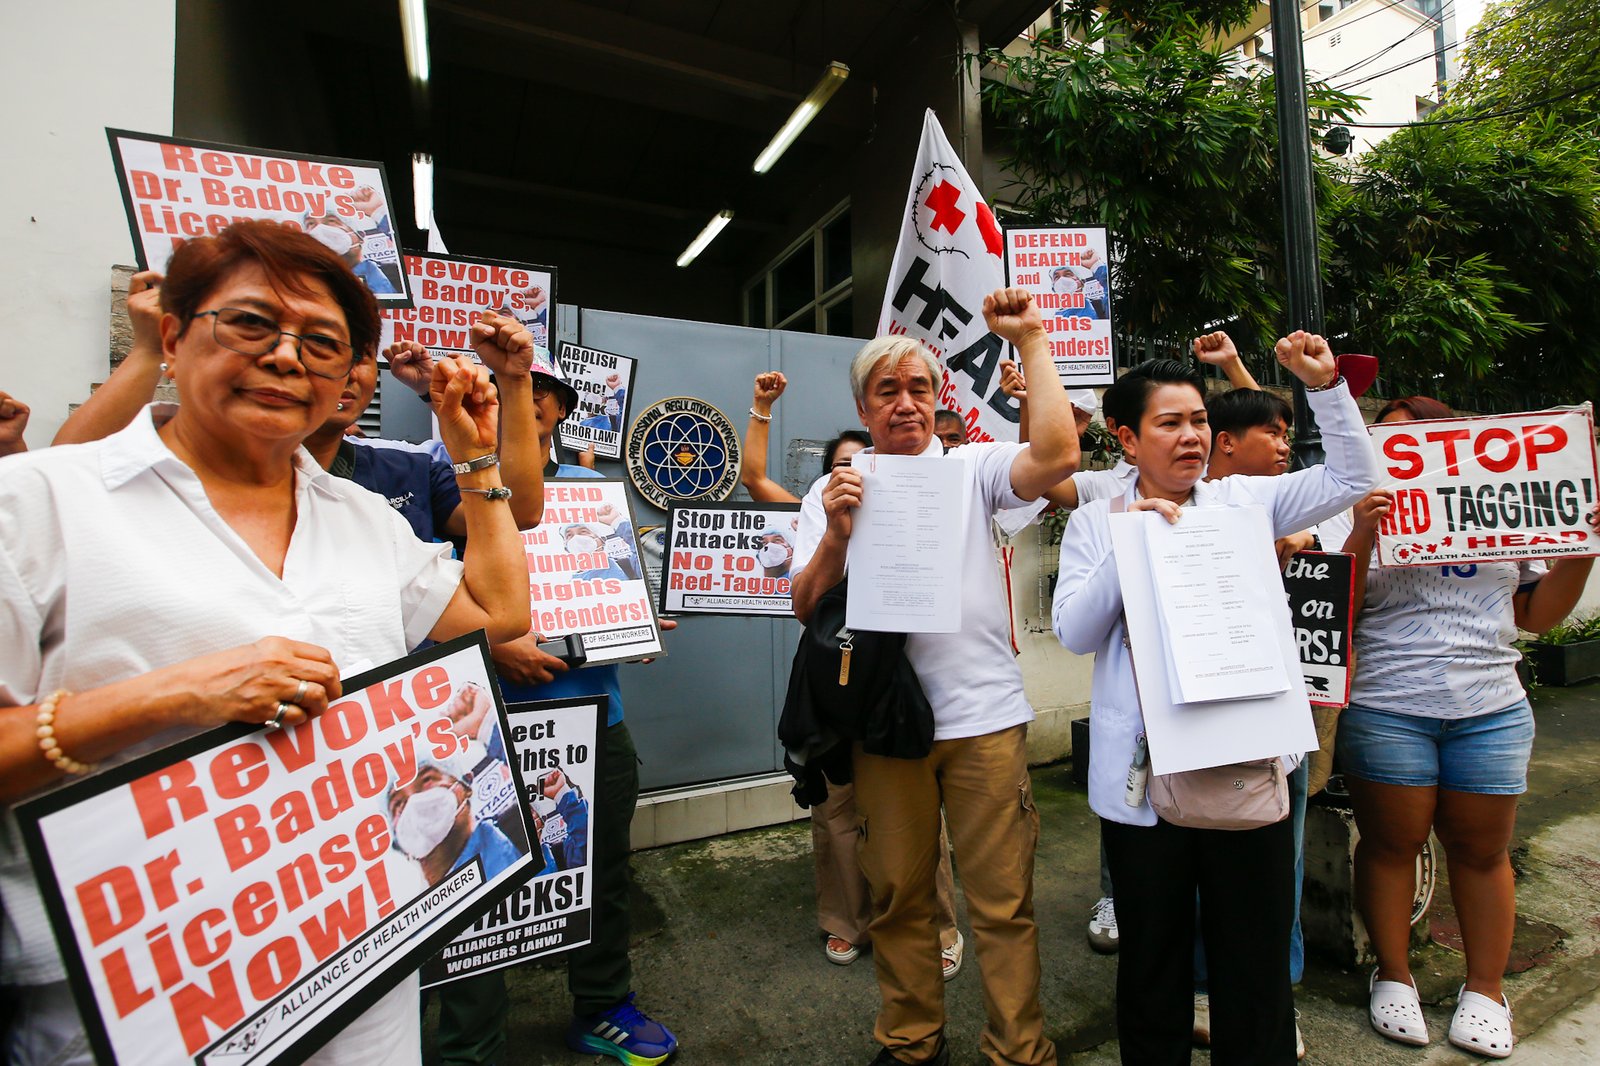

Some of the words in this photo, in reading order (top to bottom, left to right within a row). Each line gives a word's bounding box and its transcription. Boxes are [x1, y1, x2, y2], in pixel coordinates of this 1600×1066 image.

[160, 143, 356, 189] Revoke
[130, 170, 192, 203] Dr.
[200, 177, 364, 220] Badoy's,
[139, 204, 303, 237] Lice
[1014, 233, 1087, 249] DEFEND
[1015, 252, 1082, 267] HEALTH
[404, 255, 530, 288] Revoke
[1017, 272, 1041, 285] and
[1032, 293, 1086, 309] uman
[1045, 317, 1092, 333] ghts
[563, 346, 618, 370] ABOLISH
[1050, 337, 1110, 357] enders!
[561, 422, 592, 440] ERROR
[594, 429, 617, 445] LAW!
[629, 407, 665, 460] PROFESSIONAL
[665, 400, 712, 419] REGULATION
[711, 413, 739, 464] COMMISSION
[1383, 424, 1569, 480] STOP
[544, 487, 603, 503] FEND
[631, 465, 664, 504] REPUBLIC
[542, 507, 598, 524] ALTH
[1380, 488, 1432, 536] RED
[1436, 478, 1594, 533] TAGGING!
[677, 509, 725, 531] Stop
[731, 511, 766, 530] the
[674, 531, 769, 552] Attacks,
[1467, 530, 1588, 549] HEAD
[672, 552, 713, 570] No
[723, 554, 755, 571] to
[1421, 553, 1458, 561] HEALTH
[1531, 546, 1589, 555] DEMOCRACY
[1285, 558, 1330, 580] the
[530, 578, 622, 602] Rights
[670, 572, 790, 595] Red-Tagge
[531, 598, 650, 633] defenders!
[1301, 599, 1336, 620] on
[589, 634, 598, 644] OF
[598, 630, 621, 643] HEALTH
[621, 628, 650, 640] WORKERS
[130, 666, 451, 839] Revoke
[566, 744, 588, 765] to
[74, 847, 205, 948] Dr.
[214, 715, 470, 873] Badoy's,
[100, 814, 391, 1020] License
[281, 959, 351, 1020] ALLIANCE
[353, 947, 372, 964] OF
[372, 909, 420, 949] HEALTH
[420, 868, 475, 913] WORKERS
[442, 933, 504, 960] ALLIANCE
[506, 928, 522, 944] OF
[524, 917, 567, 938] HEALTH
[169, 859, 396, 1057] Now!
[447, 945, 518, 975] WORKERS
[521, 932, 563, 955] (AHW)
